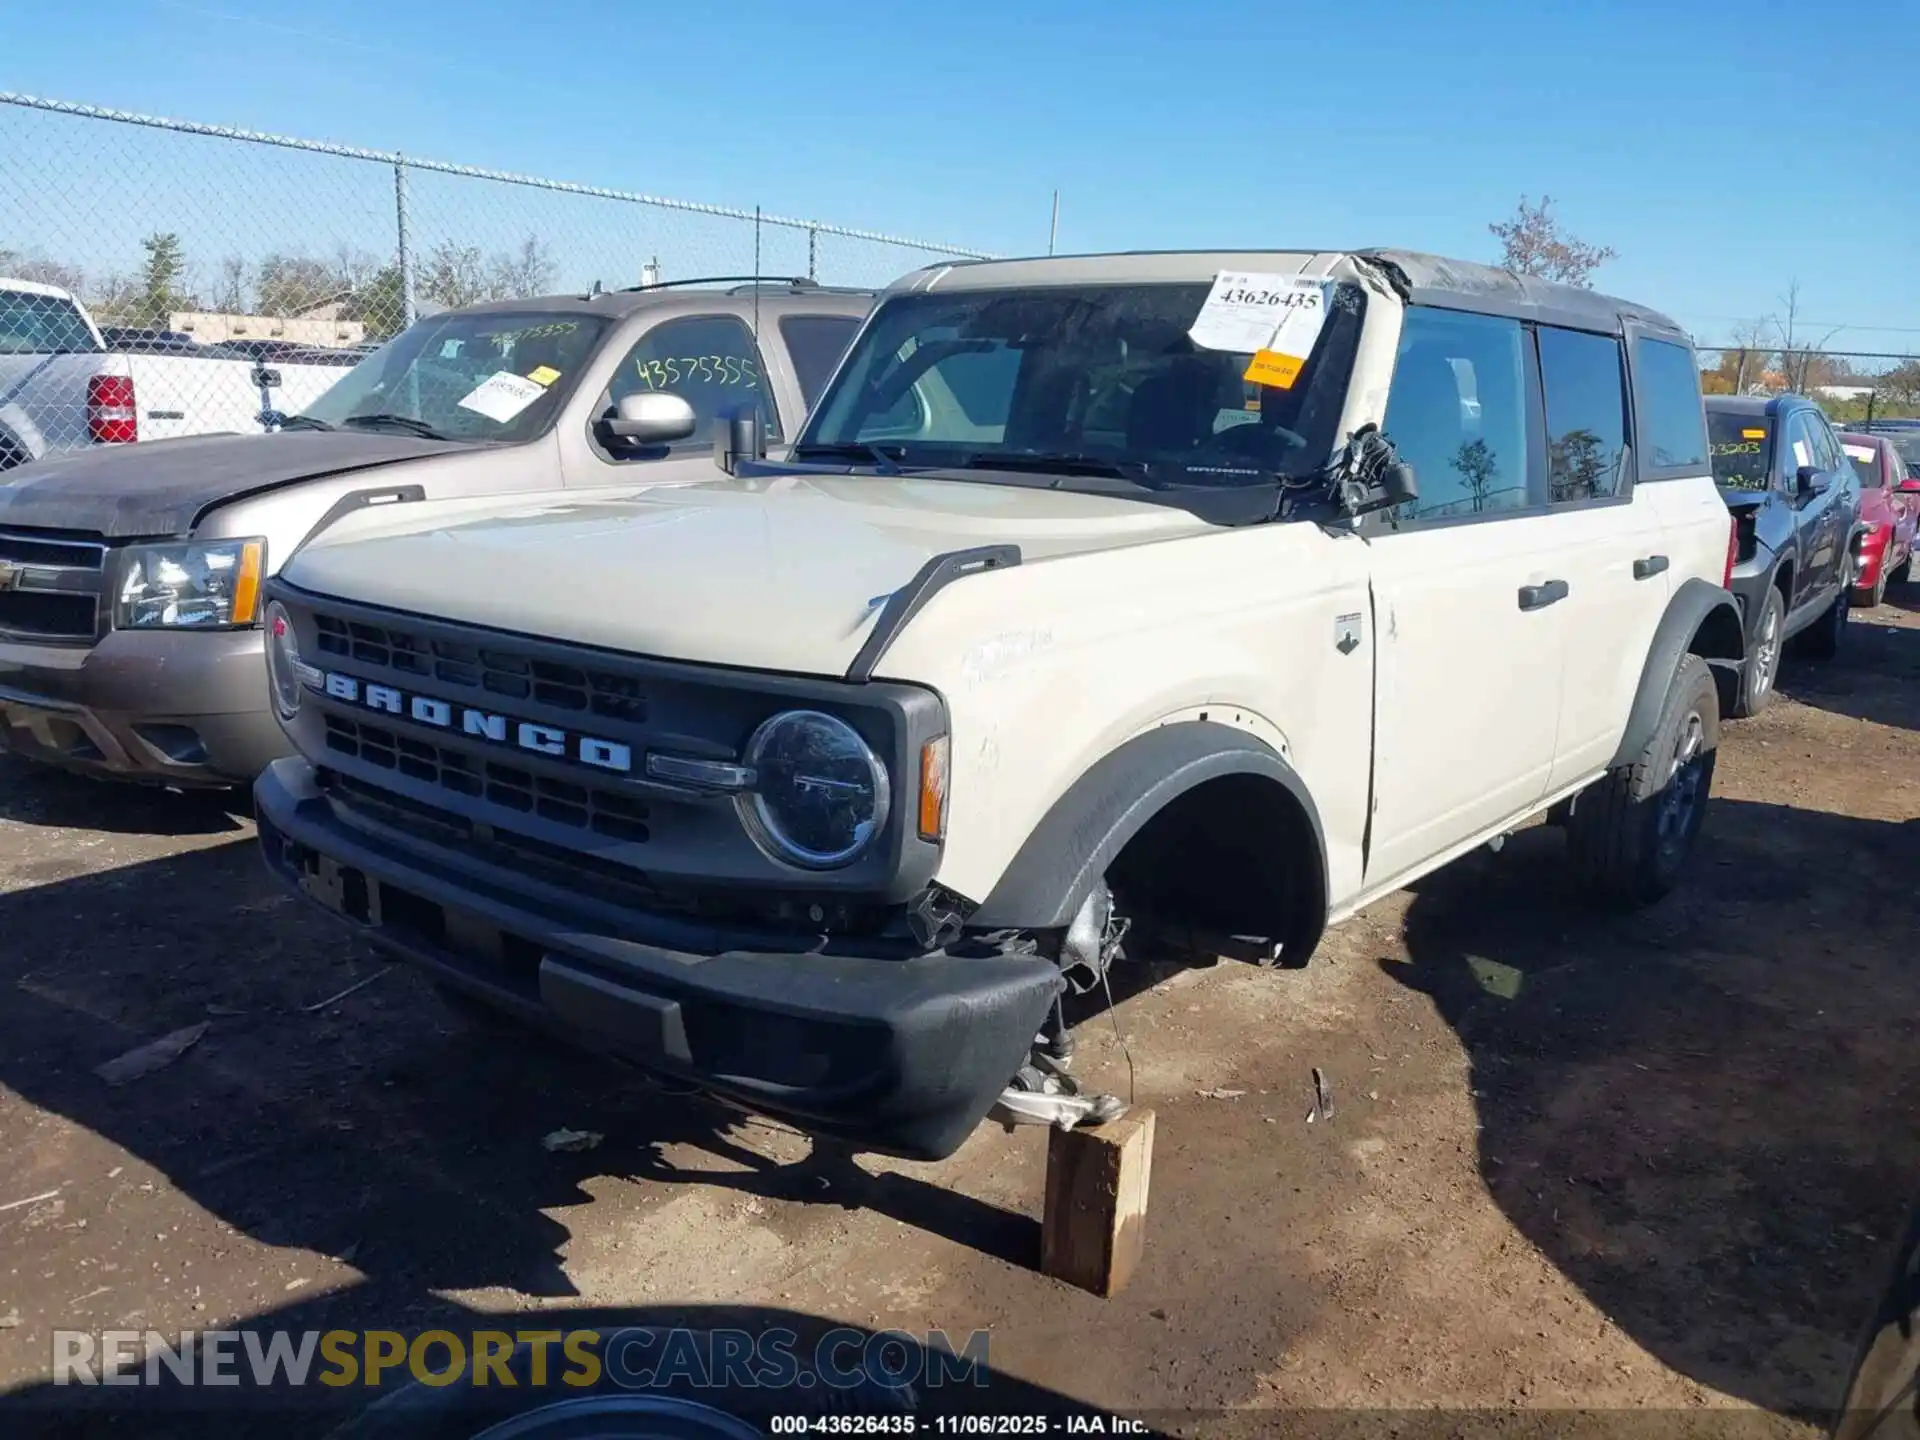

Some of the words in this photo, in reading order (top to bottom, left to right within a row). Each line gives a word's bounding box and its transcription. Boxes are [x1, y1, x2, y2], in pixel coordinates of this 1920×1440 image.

[1220, 287, 1320, 310] 43626435
[636, 355, 758, 392] 43575355
[326, 671, 631, 771] BRONCO
